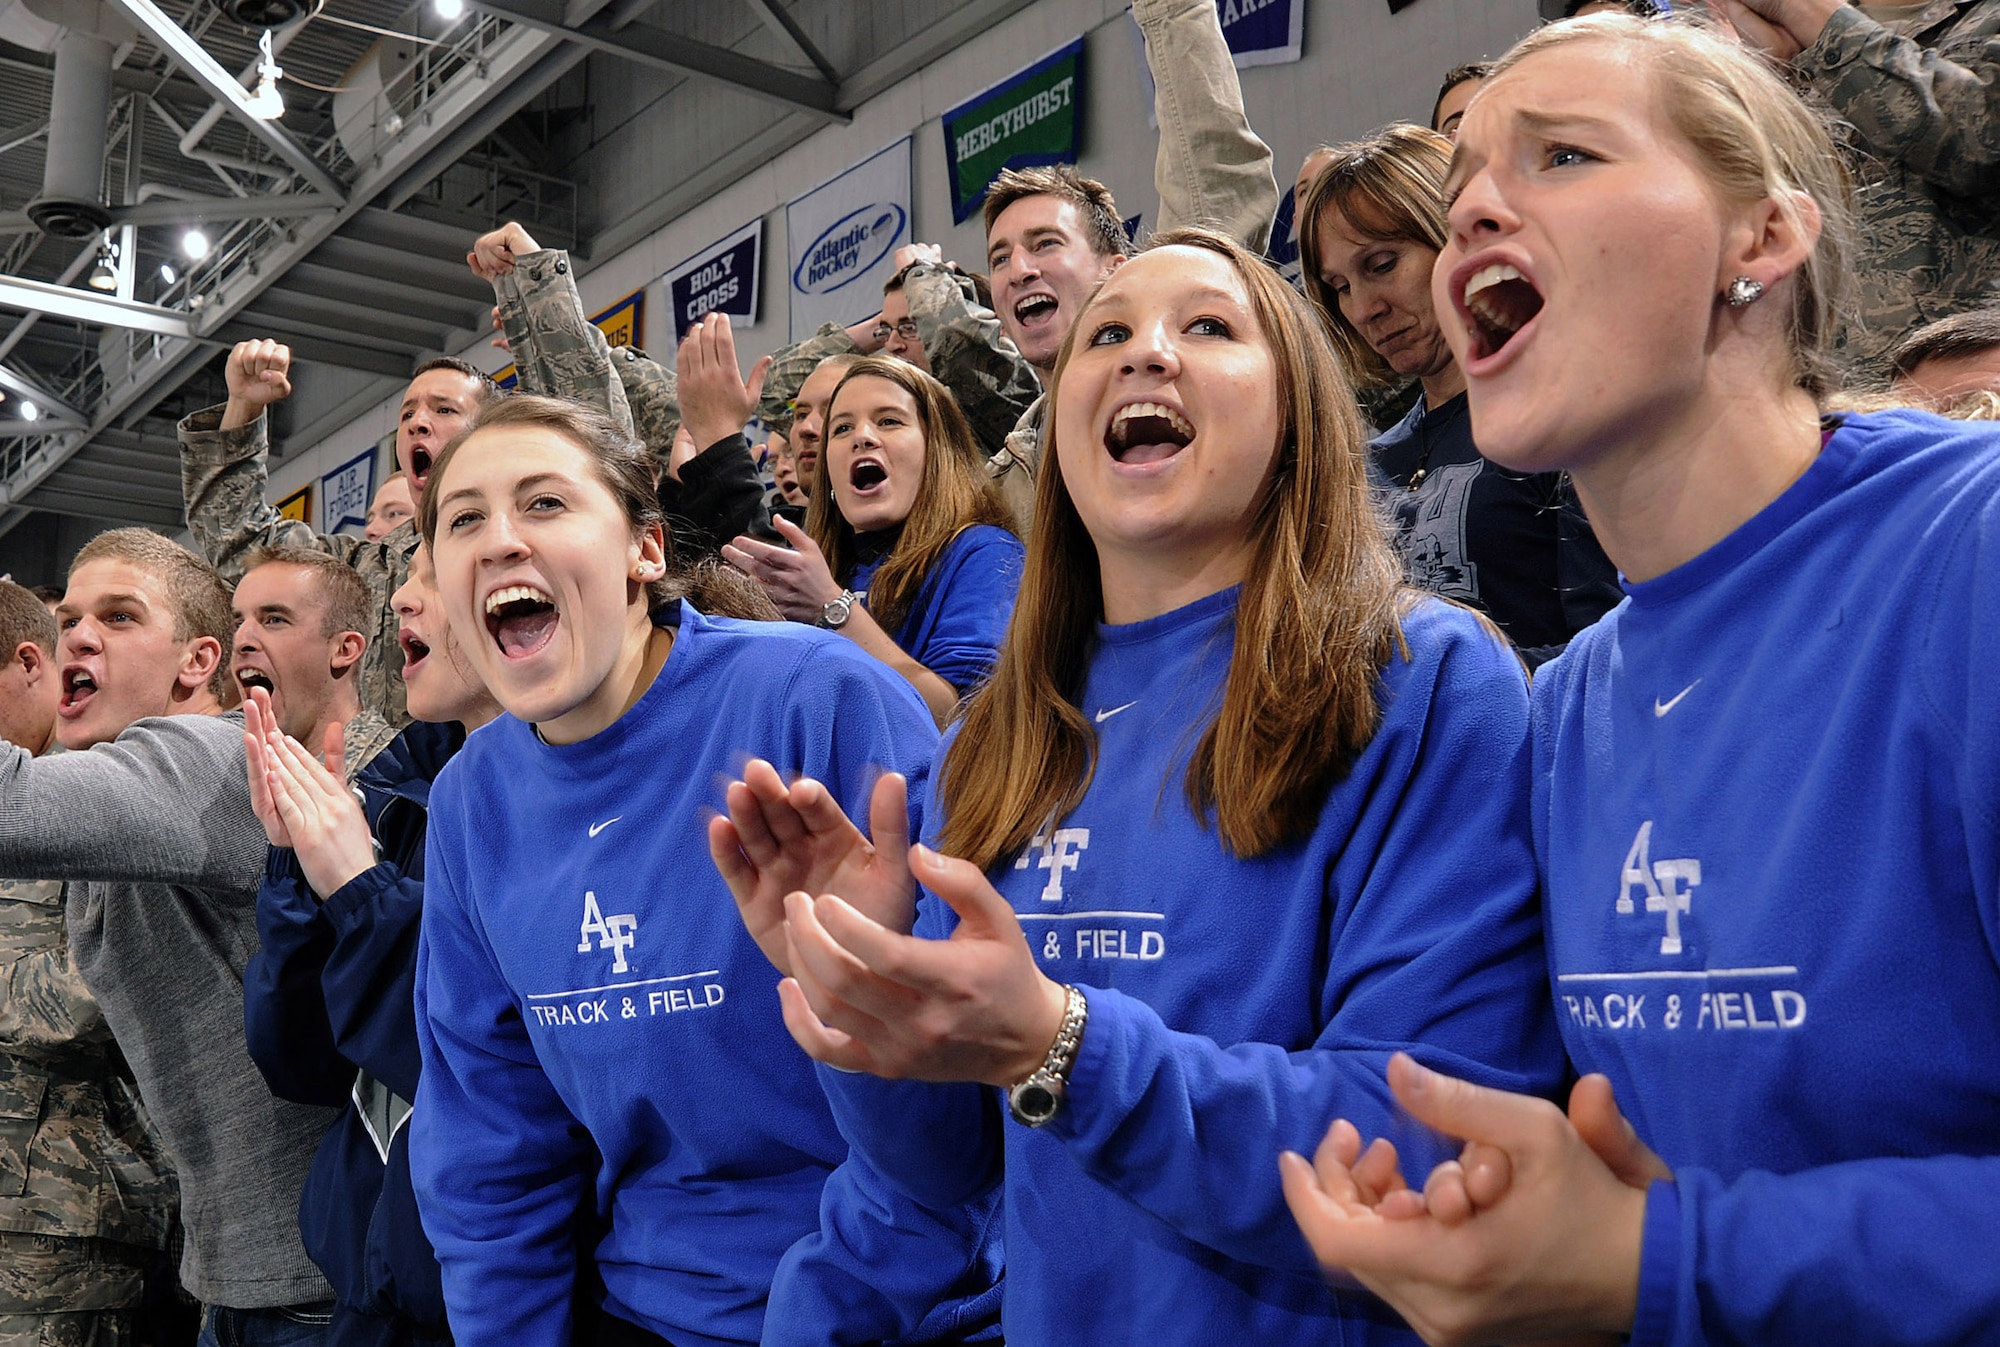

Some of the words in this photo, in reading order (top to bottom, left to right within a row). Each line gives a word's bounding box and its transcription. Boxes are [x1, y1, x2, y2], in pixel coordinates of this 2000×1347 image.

[956, 76, 1074, 163] MERCYHURST
[808, 247, 861, 286] hockey
[812, 224, 869, 267] atlantic
[690, 252, 735, 295] HOLY
[686, 276, 740, 322] CROSS
[329, 484, 365, 520] FORCE
[337, 467, 357, 495] AIR
[1616, 820, 1701, 955] AF
[577, 891, 638, 974] AF
[1043, 931, 1061, 960] &
[1075, 929, 1166, 960] FIELD
[530, 999, 609, 1027] TRACK
[620, 997, 637, 1019] &
[648, 983, 725, 1016] FIELD
[1664, 994, 1682, 1029] &
